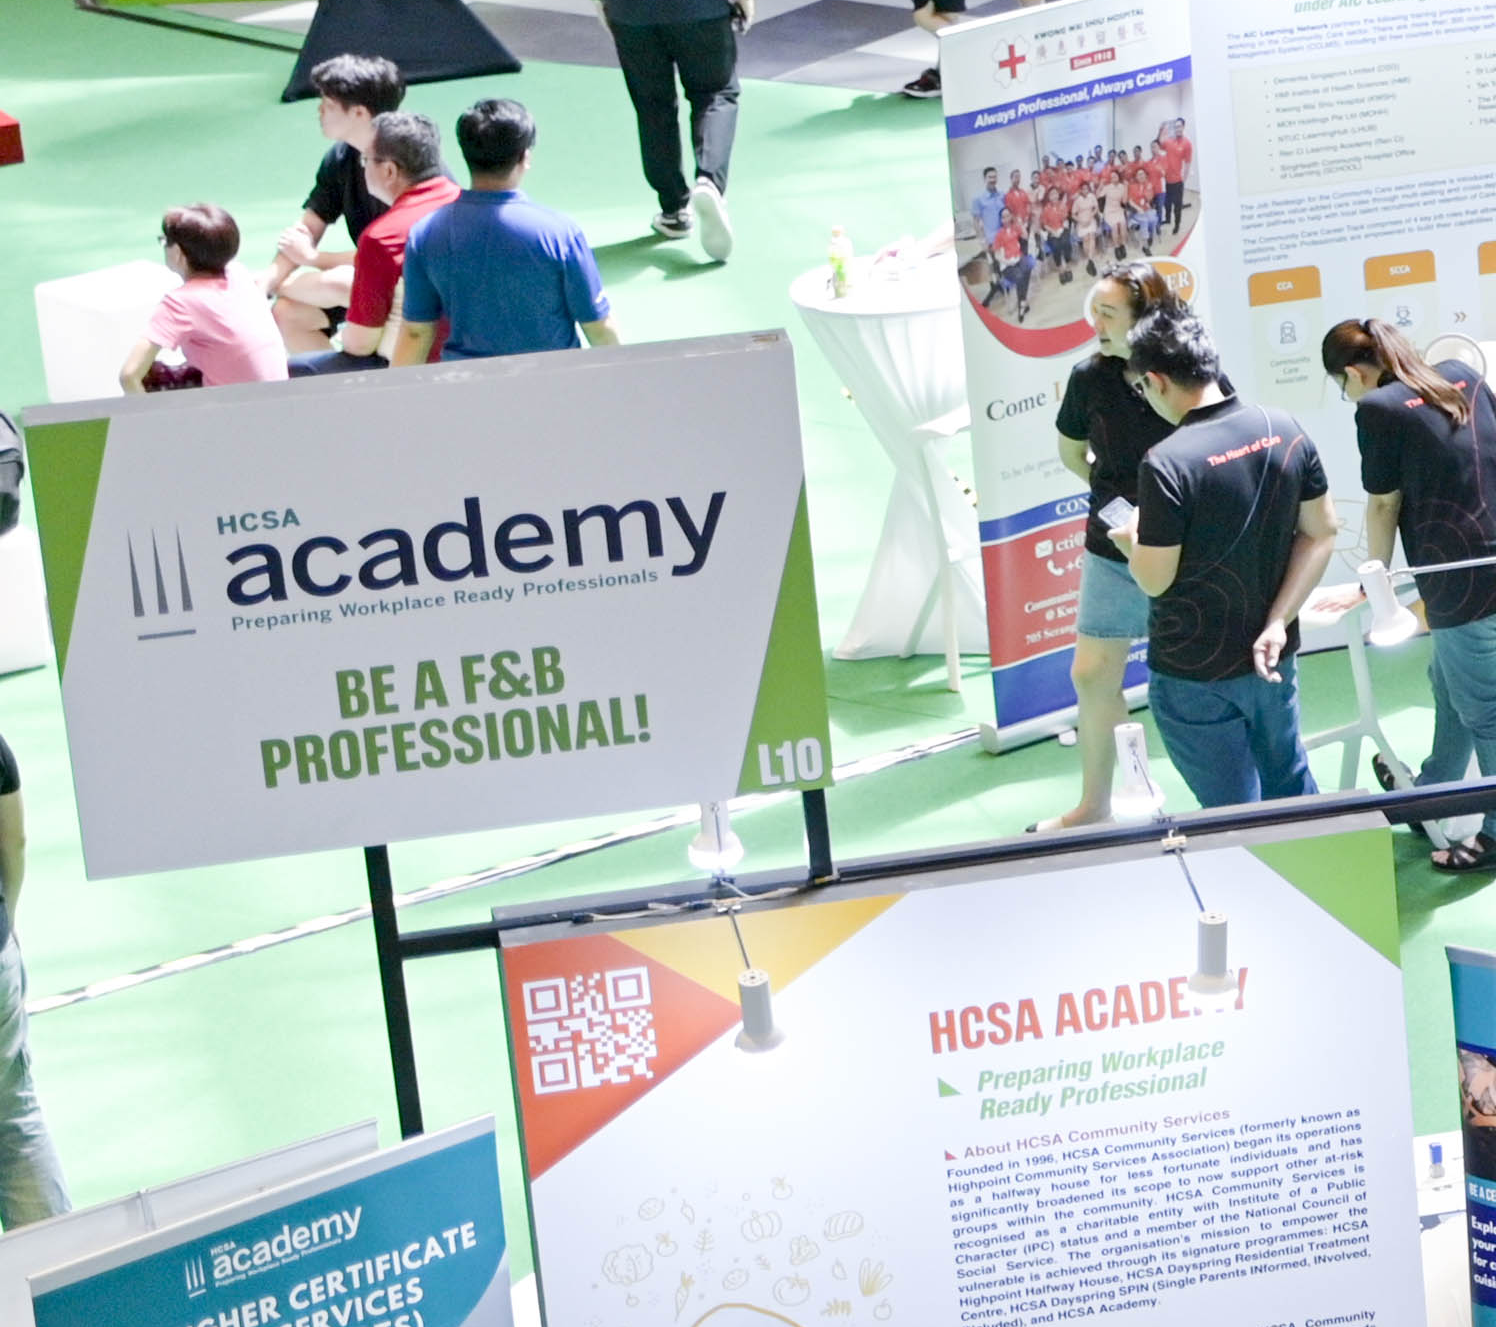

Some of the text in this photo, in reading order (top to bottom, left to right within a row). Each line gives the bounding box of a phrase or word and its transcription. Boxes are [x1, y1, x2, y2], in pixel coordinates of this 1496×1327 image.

[975, 68, 1173, 129] Always Professional, Always Caring
[1208, 454, 1226, 467] The
[1226, 445, 1250, 461] Heart
[1251, 441, 1260, 452] of
[216, 507, 301, 536] HCSA
[225, 491, 727, 607] academy
[231, 569, 660, 631] Preparing Workplace Ready Professionals
[335, 645, 565, 720] BE A F&B
[259, 693, 651, 789] PROFESSIONAL!
[758, 736, 823, 788] L10
[928, 967, 1248, 1054] HCSA ACADEY
[288, 1221, 479, 1311] CERTIFICATE
